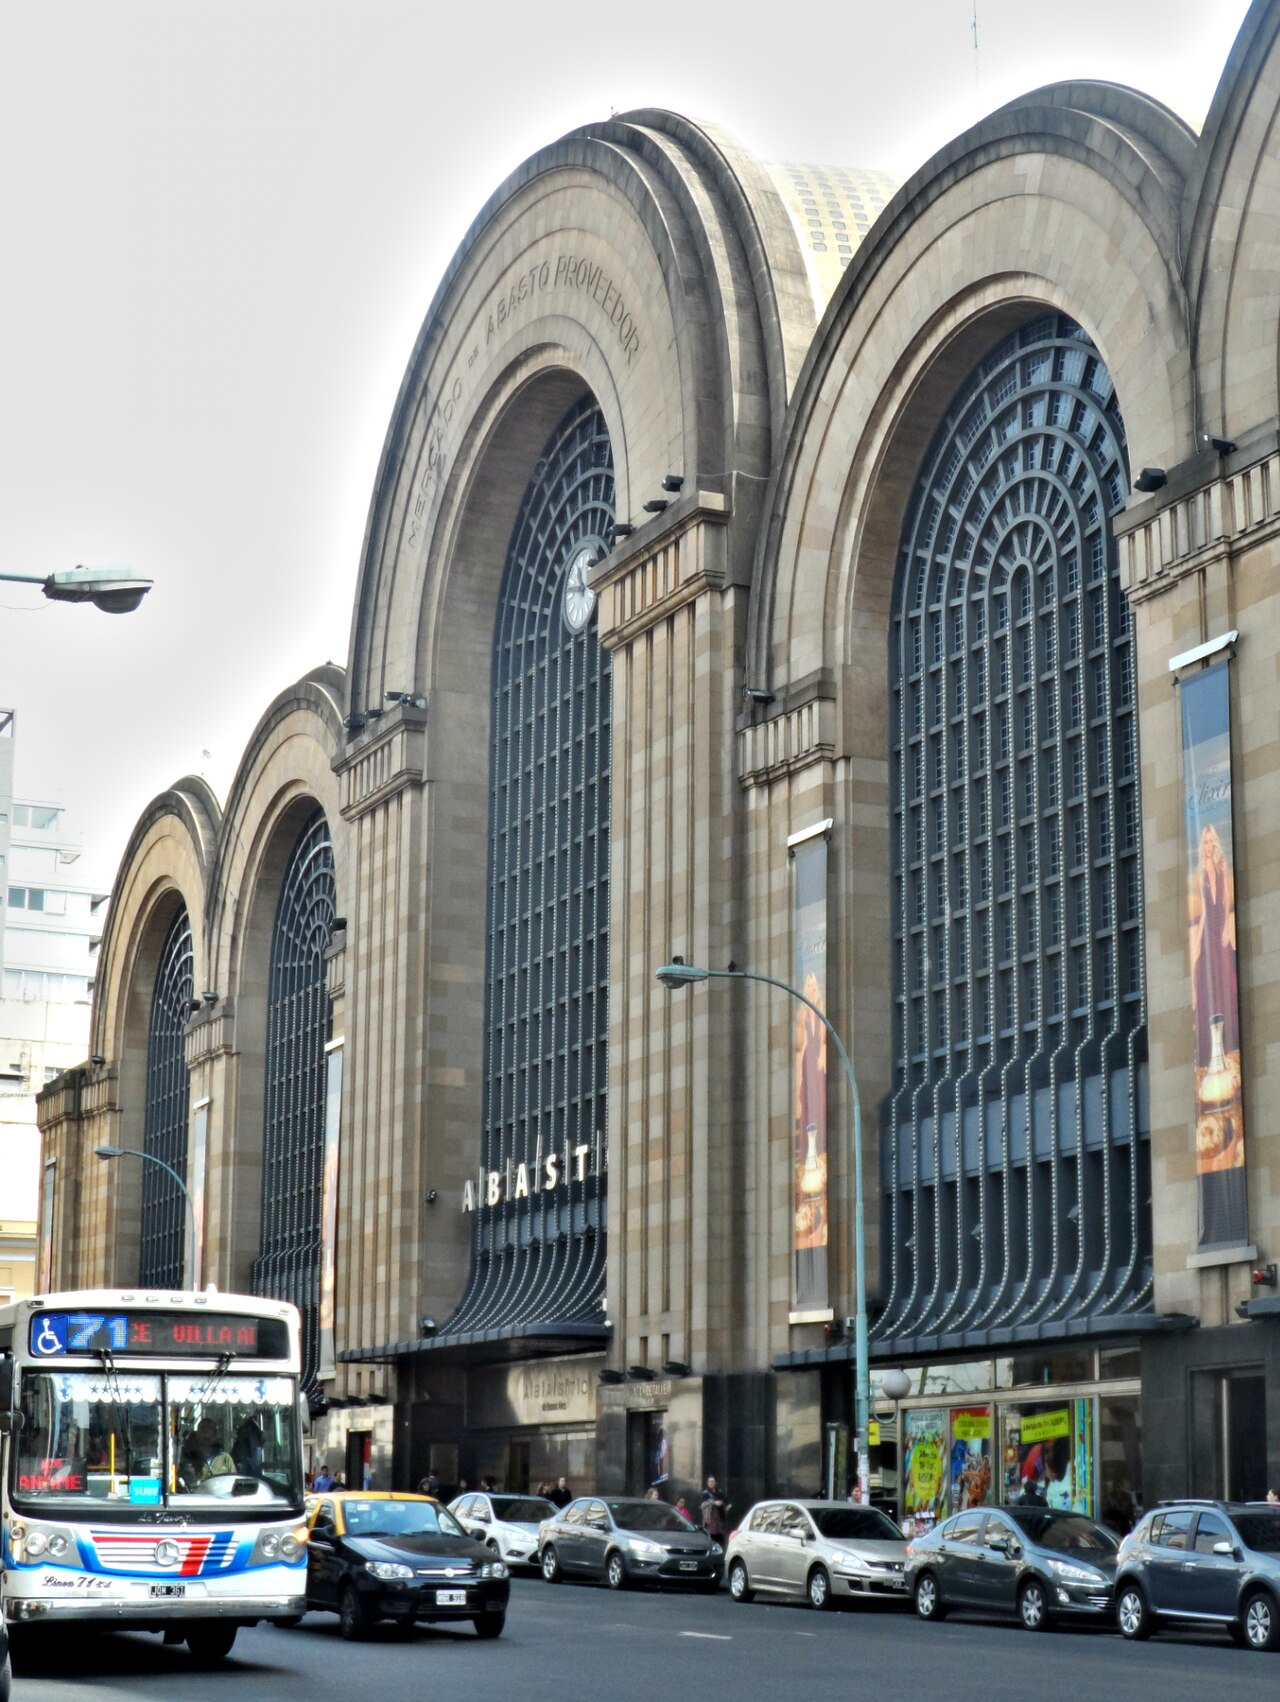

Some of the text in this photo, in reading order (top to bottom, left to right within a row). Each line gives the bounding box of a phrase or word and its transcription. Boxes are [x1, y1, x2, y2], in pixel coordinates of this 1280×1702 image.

[485, 259, 550, 345] ABASTO
[554, 254, 641, 365] PROVEEDOR
[67, 1315, 128, 1348] 71
[173, 1324, 231, 1344] VILLA
[133, 1486, 160, 1497] SUBE
[77, 1576, 96, 1588] 71
